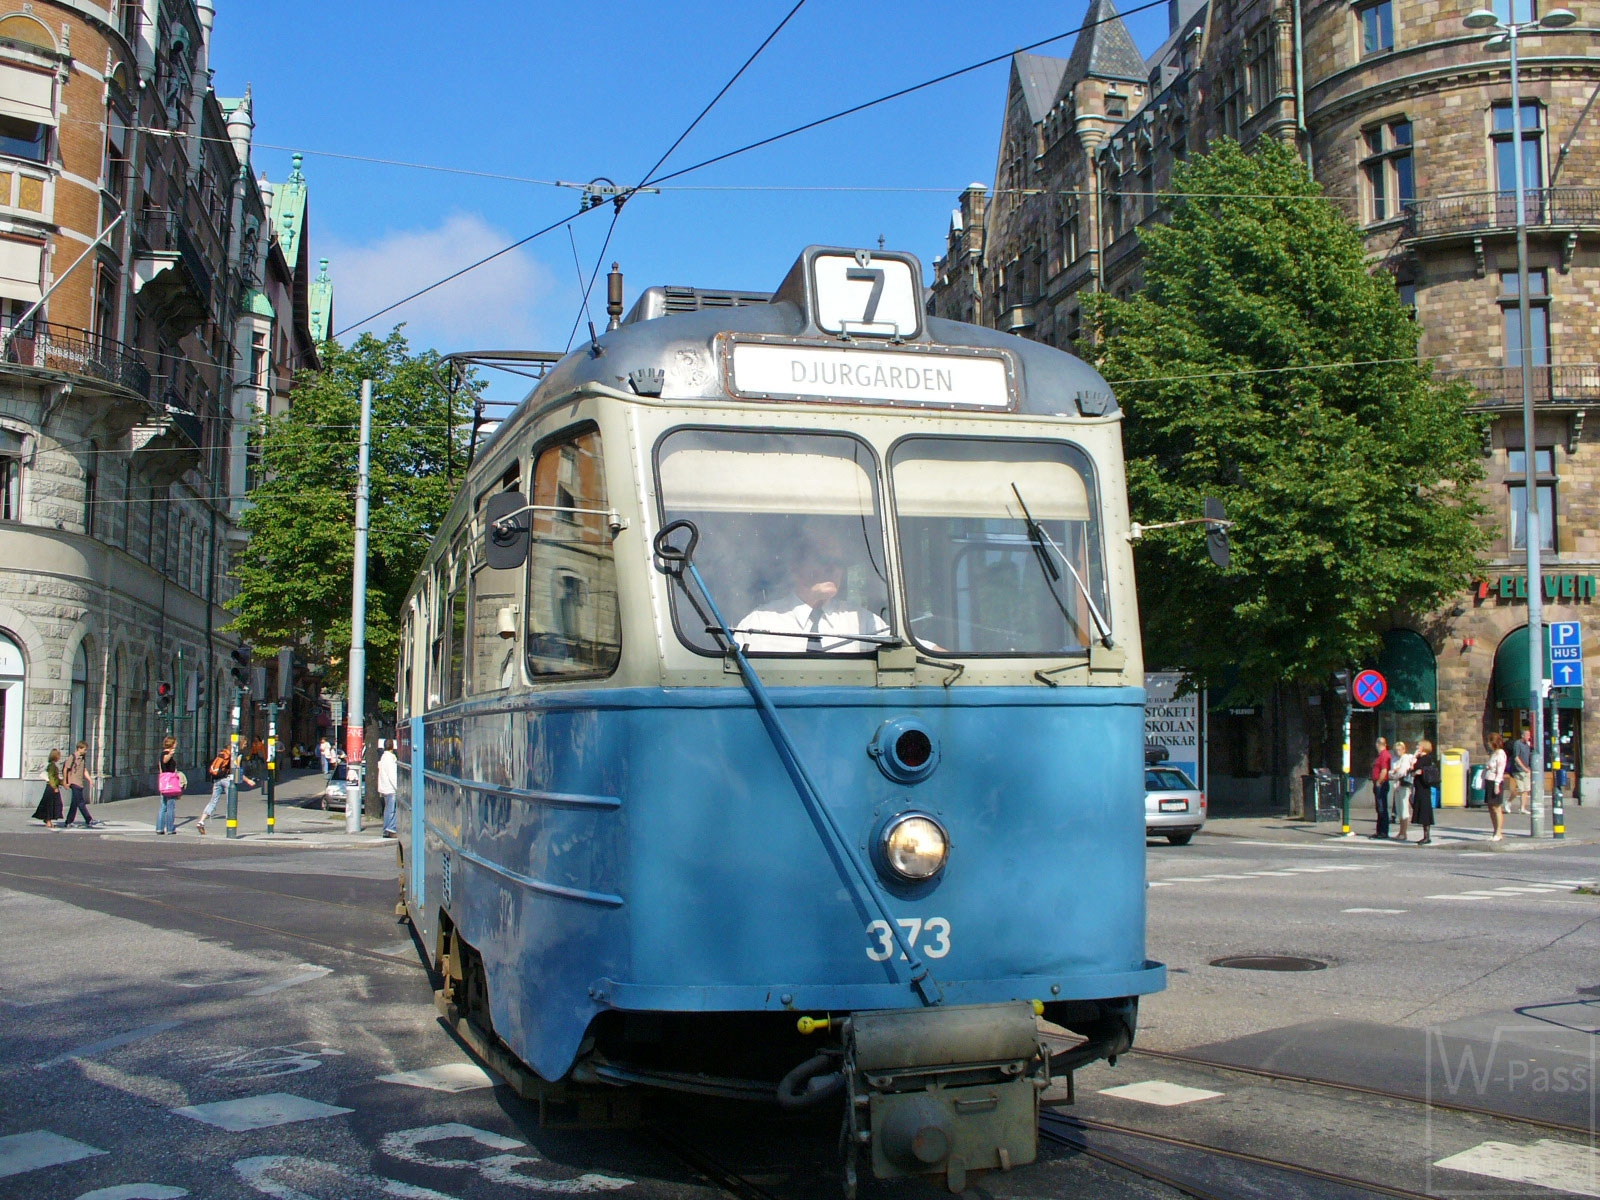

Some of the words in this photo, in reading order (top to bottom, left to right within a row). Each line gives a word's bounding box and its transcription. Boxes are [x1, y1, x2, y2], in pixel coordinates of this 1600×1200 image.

[846, 267, 885, 324] 7
[790, 359, 953, 391] DJURGÅRDEN
[1559, 624, 1574, 645] P
[1553, 648, 1578, 658] HUS
[1145, 705, 1188, 718] STÖKET
[1145, 720, 1195, 733] SKOLAN
[1145, 735, 1196, 746] MINSKAR
[866, 917, 951, 961] 373
